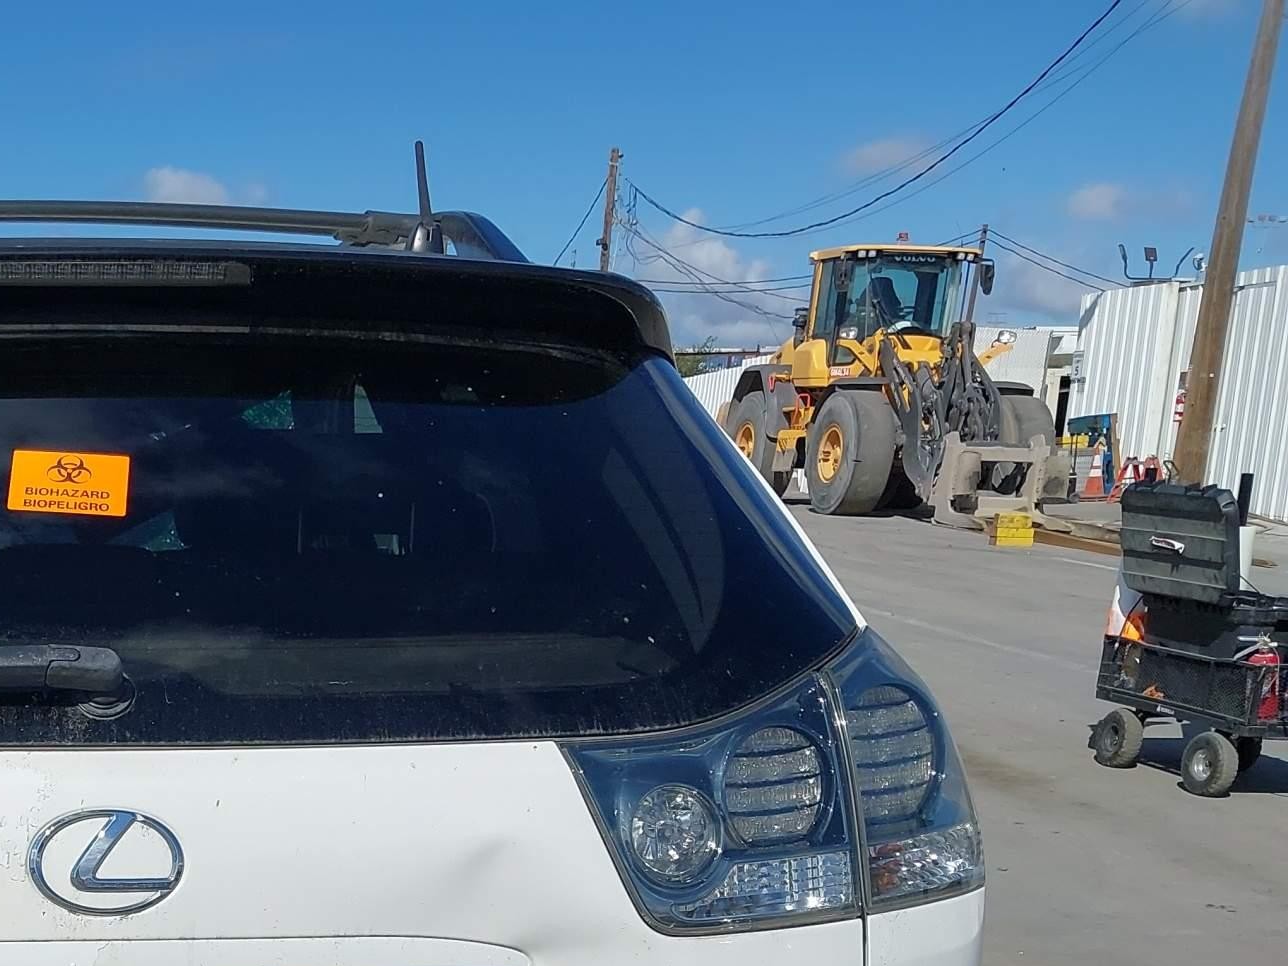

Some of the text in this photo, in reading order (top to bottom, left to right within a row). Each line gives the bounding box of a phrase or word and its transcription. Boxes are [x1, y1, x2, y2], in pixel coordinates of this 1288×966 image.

[895, 255, 936, 263] VOLVO
[24, 486, 111, 500] BIOHAZARD
[23, 498, 110, 512] BIOPELIGRO
